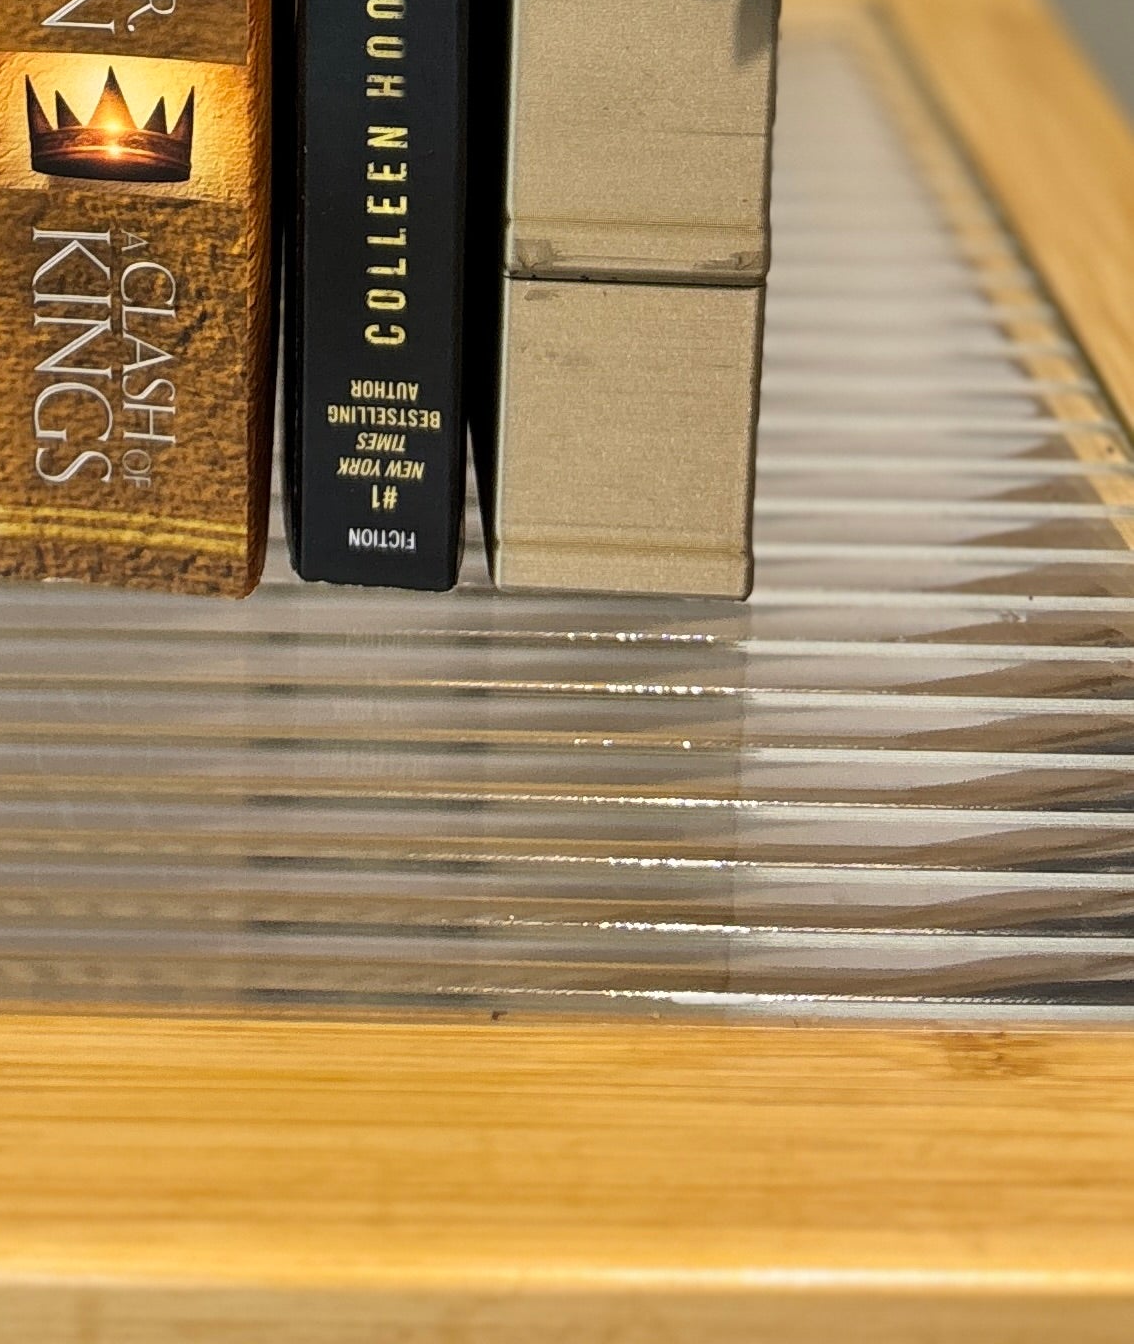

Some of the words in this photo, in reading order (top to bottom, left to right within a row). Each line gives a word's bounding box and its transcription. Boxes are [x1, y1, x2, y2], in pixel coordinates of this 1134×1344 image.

[120, 228, 150, 252] A
[364, 125, 409, 346] COLLEEN
[31, 226, 115, 484] KINGS
[120, 261, 178, 445] CLASH
[350, 379, 420, 400] AUTHOR
[327, 404, 442, 429] BESTSELLING
[355, 431, 407, 452] TIMES
[122, 448, 153, 489] OF
[336, 457, 381, 478] YORK
[384, 459, 426, 480] NEW
[371, 484, 399, 510] #1
[348, 527, 417, 551] FICTION
